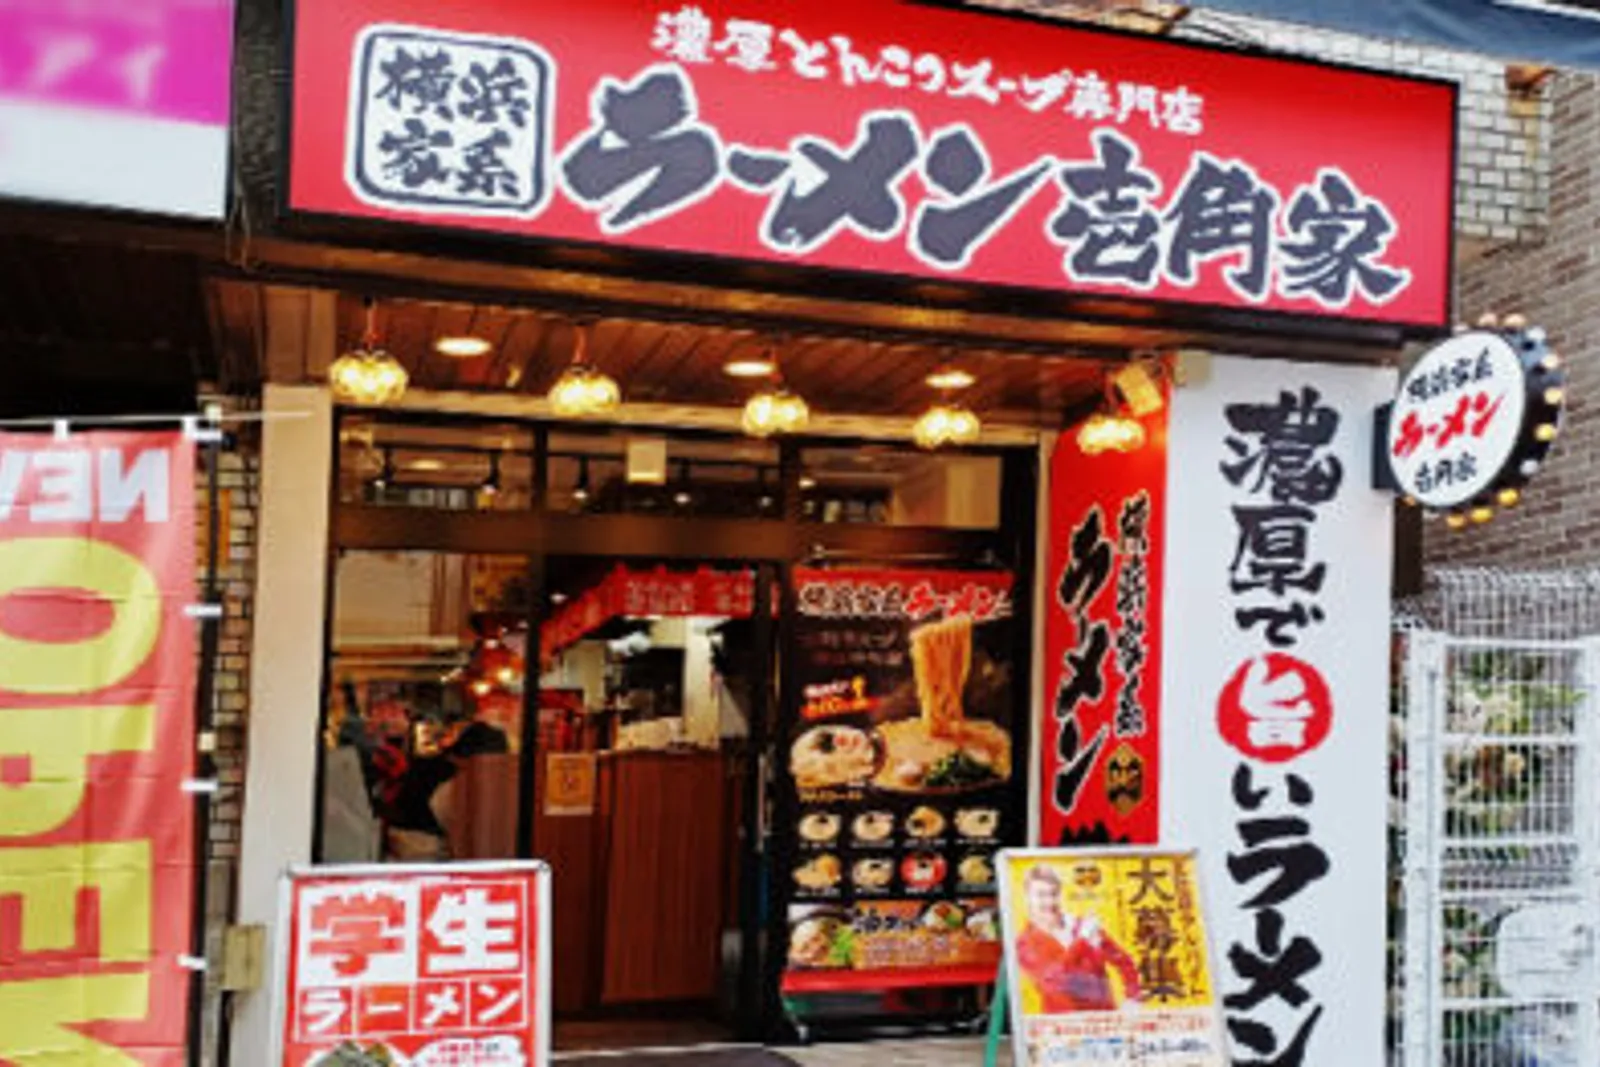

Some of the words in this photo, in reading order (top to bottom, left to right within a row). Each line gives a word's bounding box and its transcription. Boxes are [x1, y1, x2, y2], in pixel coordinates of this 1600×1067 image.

[374, 47, 531, 127] 横浜
[650, 6, 1204, 135] 濃厚とんこつスープ専門店
[378, 119, 520, 197] 家系
[553, 64, 1412, 307] ラーメン壱角家
[1392, 391, 1505, 457] ラーメン
[1055, 501, 1114, 816] ラーメン
[309, 887, 520, 978] 学生
[303, 983, 521, 1032] ラーメン
